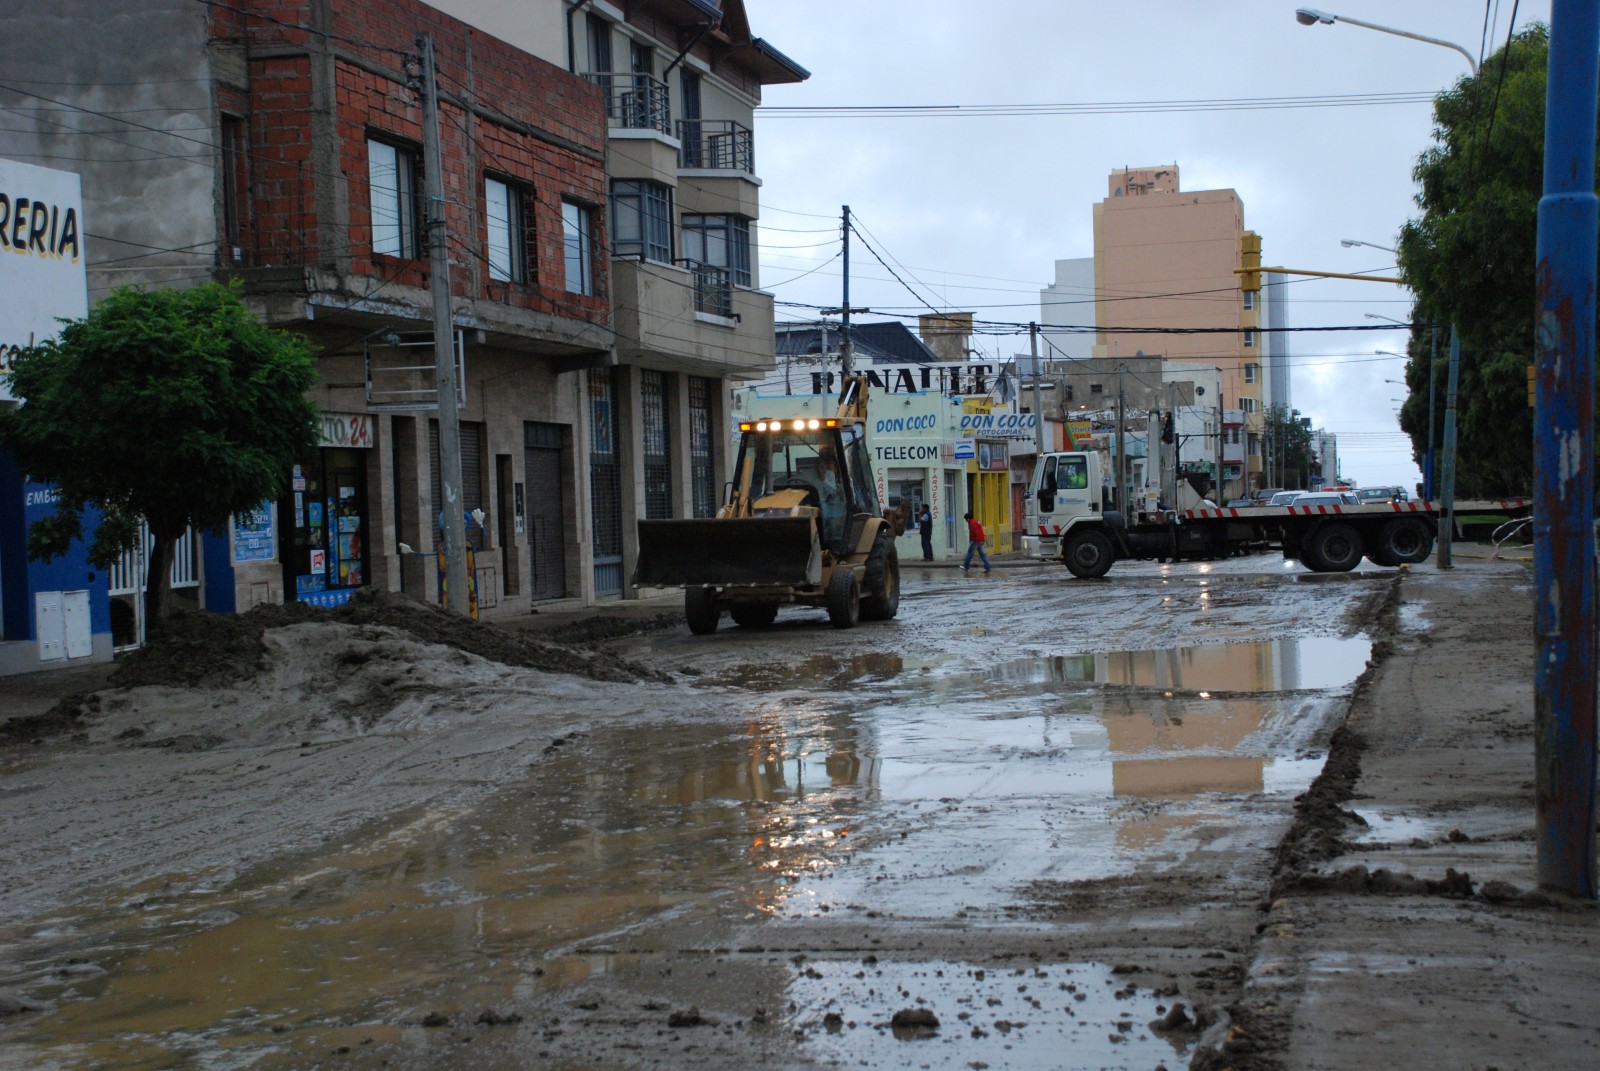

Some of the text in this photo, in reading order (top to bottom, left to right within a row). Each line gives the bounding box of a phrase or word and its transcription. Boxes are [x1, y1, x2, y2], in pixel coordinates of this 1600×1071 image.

[350, 414, 367, 446] 24
[876, 414, 936, 433] DON COCO
[960, 414, 1037, 429] DON COCO
[976, 428, 1023, 436] FOTOCOPIAS
[875, 446, 938, 460] TELECOM
[931, 467, 939, 520] TARJETAS
